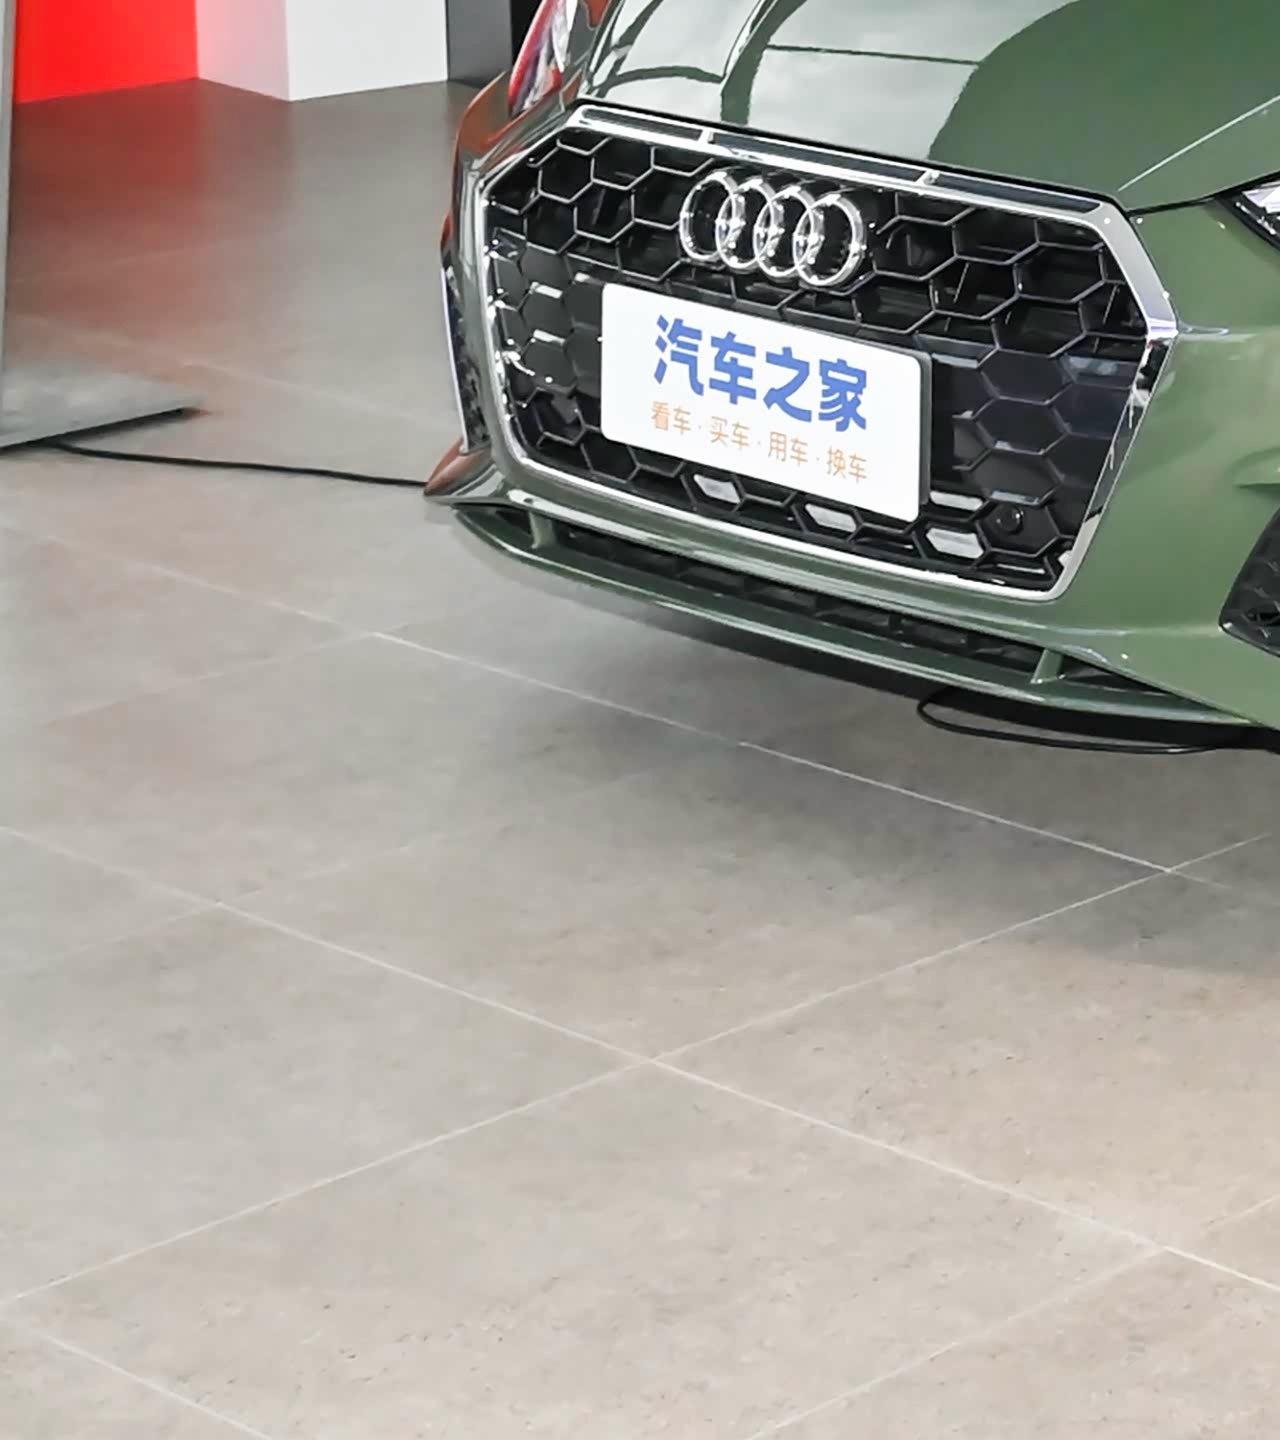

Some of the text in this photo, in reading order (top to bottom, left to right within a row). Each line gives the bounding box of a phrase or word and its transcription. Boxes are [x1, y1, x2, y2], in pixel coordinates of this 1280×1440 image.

[653, 314, 868, 432] 汽车之家
[651, 401, 867, 483] 看车 买车 用车 换车
